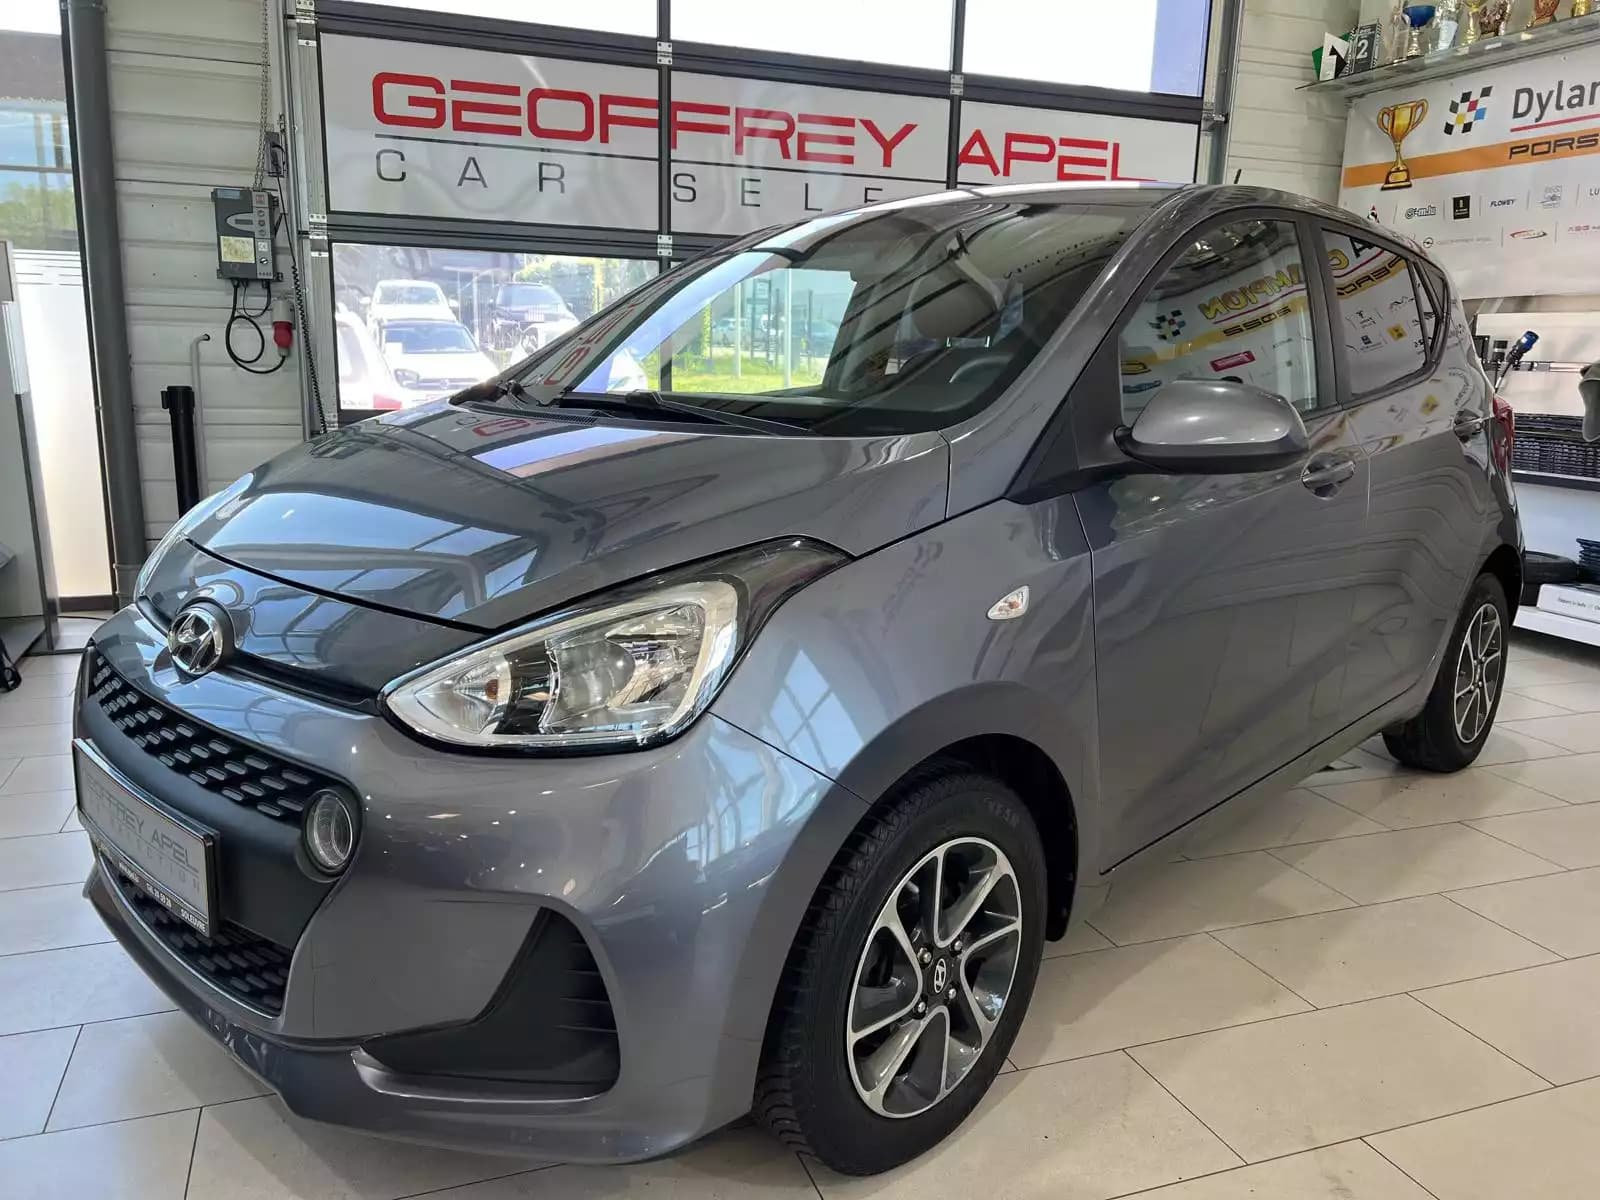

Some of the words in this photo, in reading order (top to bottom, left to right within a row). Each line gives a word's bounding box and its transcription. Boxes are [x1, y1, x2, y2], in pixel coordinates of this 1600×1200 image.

[372, 72, 918, 168] GEOFFREY
[958, 129, 1158, 182] APEL
[375, 149, 566, 194] CAR
